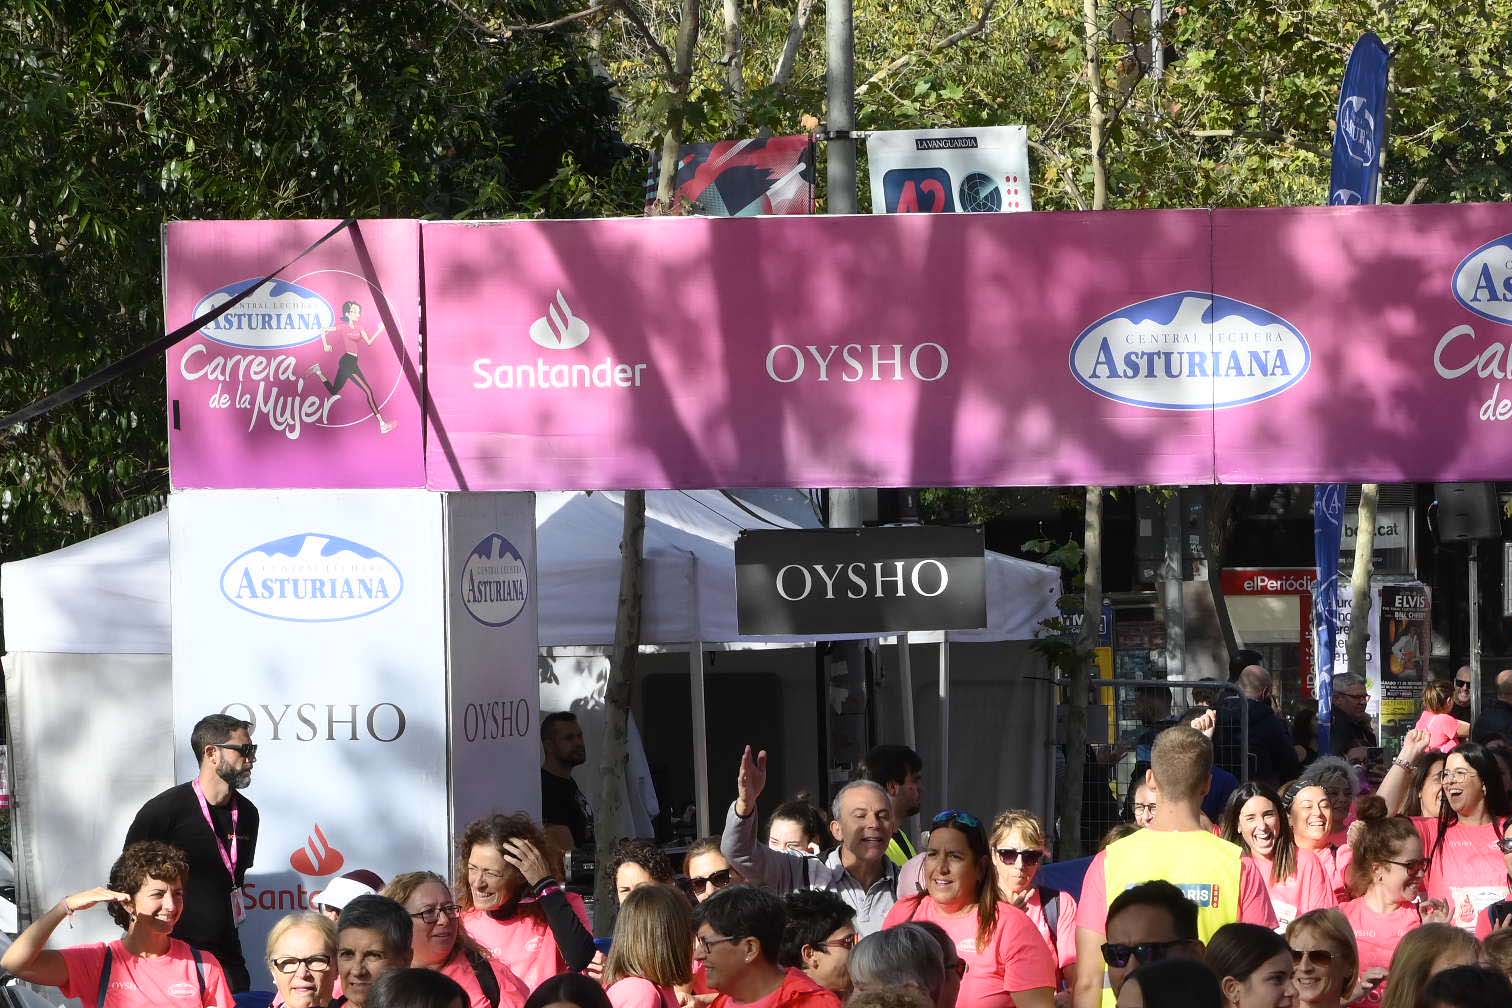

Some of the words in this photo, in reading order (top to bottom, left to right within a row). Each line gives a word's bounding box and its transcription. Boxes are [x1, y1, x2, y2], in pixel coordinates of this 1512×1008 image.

[927, 137, 978, 149] VANGUARDIA
[204, 304, 322, 331] ASTURIANA
[1125, 333, 1200, 345] CENTRAL
[180, 343, 298, 381] Carrera
[472, 358, 647, 390] Santander
[765, 342, 950, 384] OYSHO
[1088, 336, 1292, 380] ASTURIANA
[209, 384, 231, 409] de
[235, 383, 251, 409] la
[249, 379, 342, 440] Mujer
[235, 566, 390, 600] ASTURIANA
[466, 569, 525, 604] ASTURIANA
[775, 559, 950, 602] OYSHO
[1395, 594, 1425, 608] ELVIS
[463, 698, 530, 743] OYSHO
